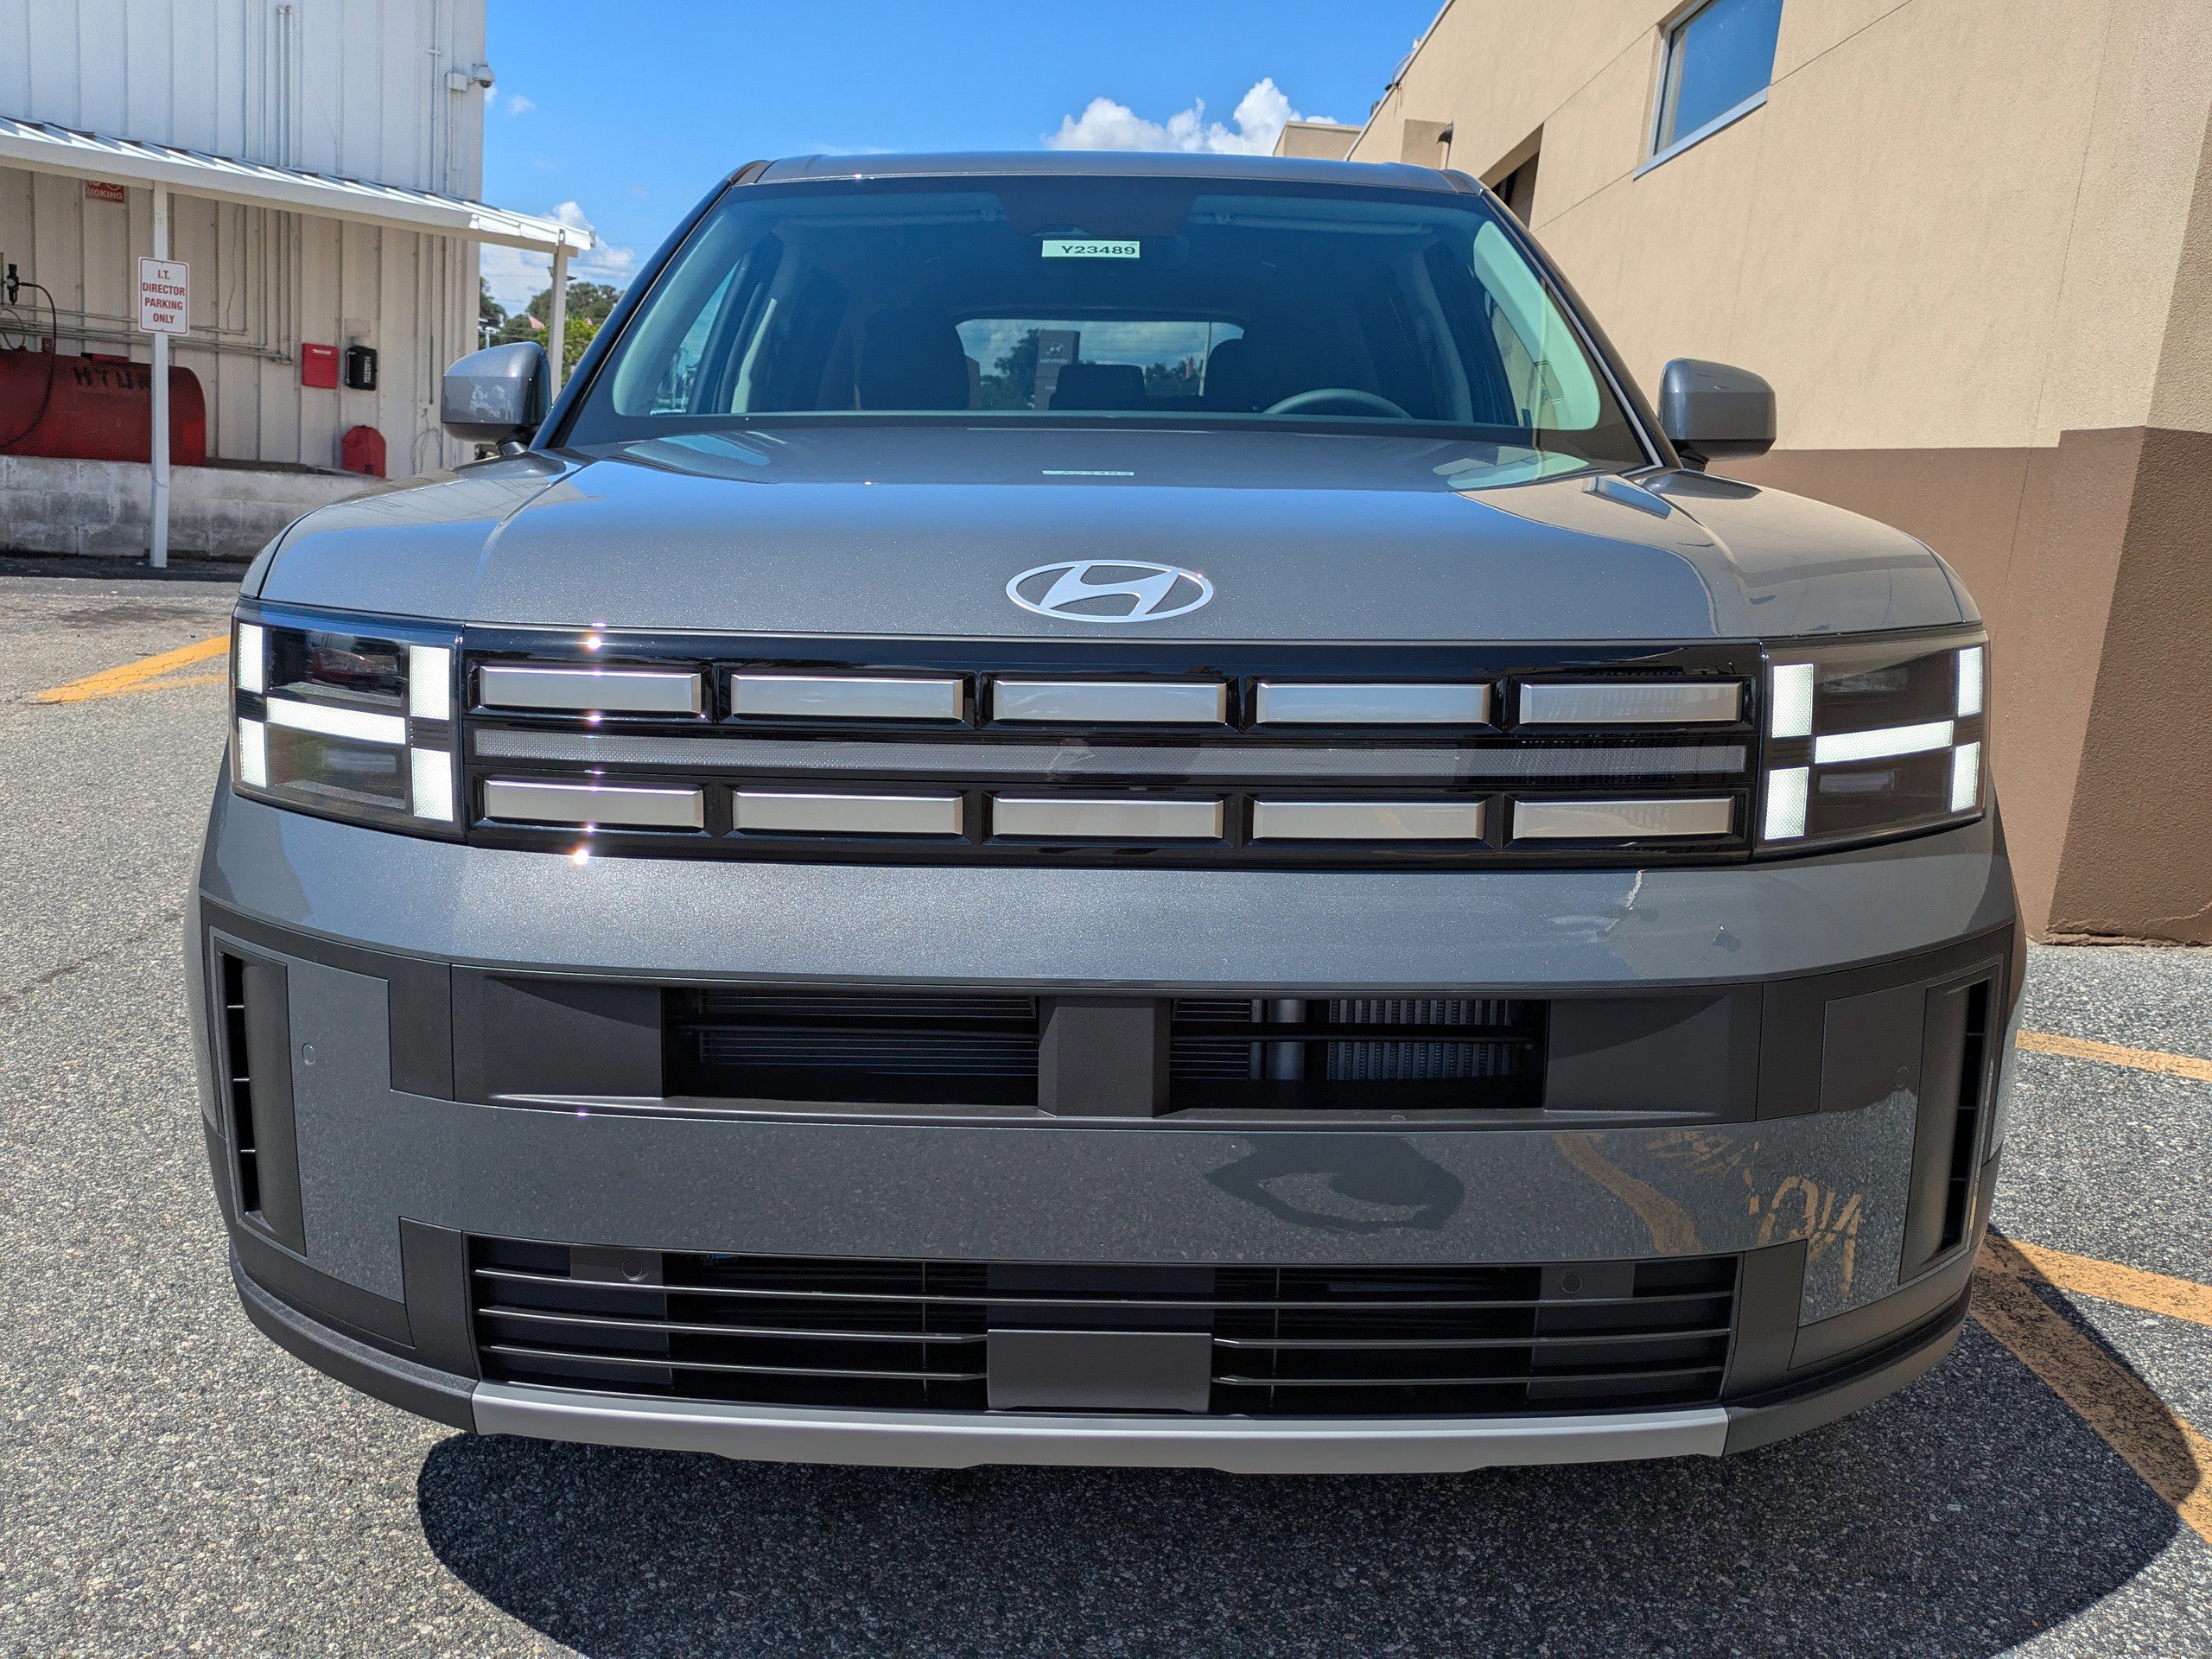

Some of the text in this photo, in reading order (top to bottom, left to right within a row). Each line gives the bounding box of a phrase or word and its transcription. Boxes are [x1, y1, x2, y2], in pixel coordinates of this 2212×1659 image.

[1061, 245, 1136, 255] Y23489
[157, 270, 170, 280] I.T.
[143, 283, 185, 296] DIRECTOR
[144, 297, 183, 310] PARKING
[153, 313, 175, 324] ONLY
